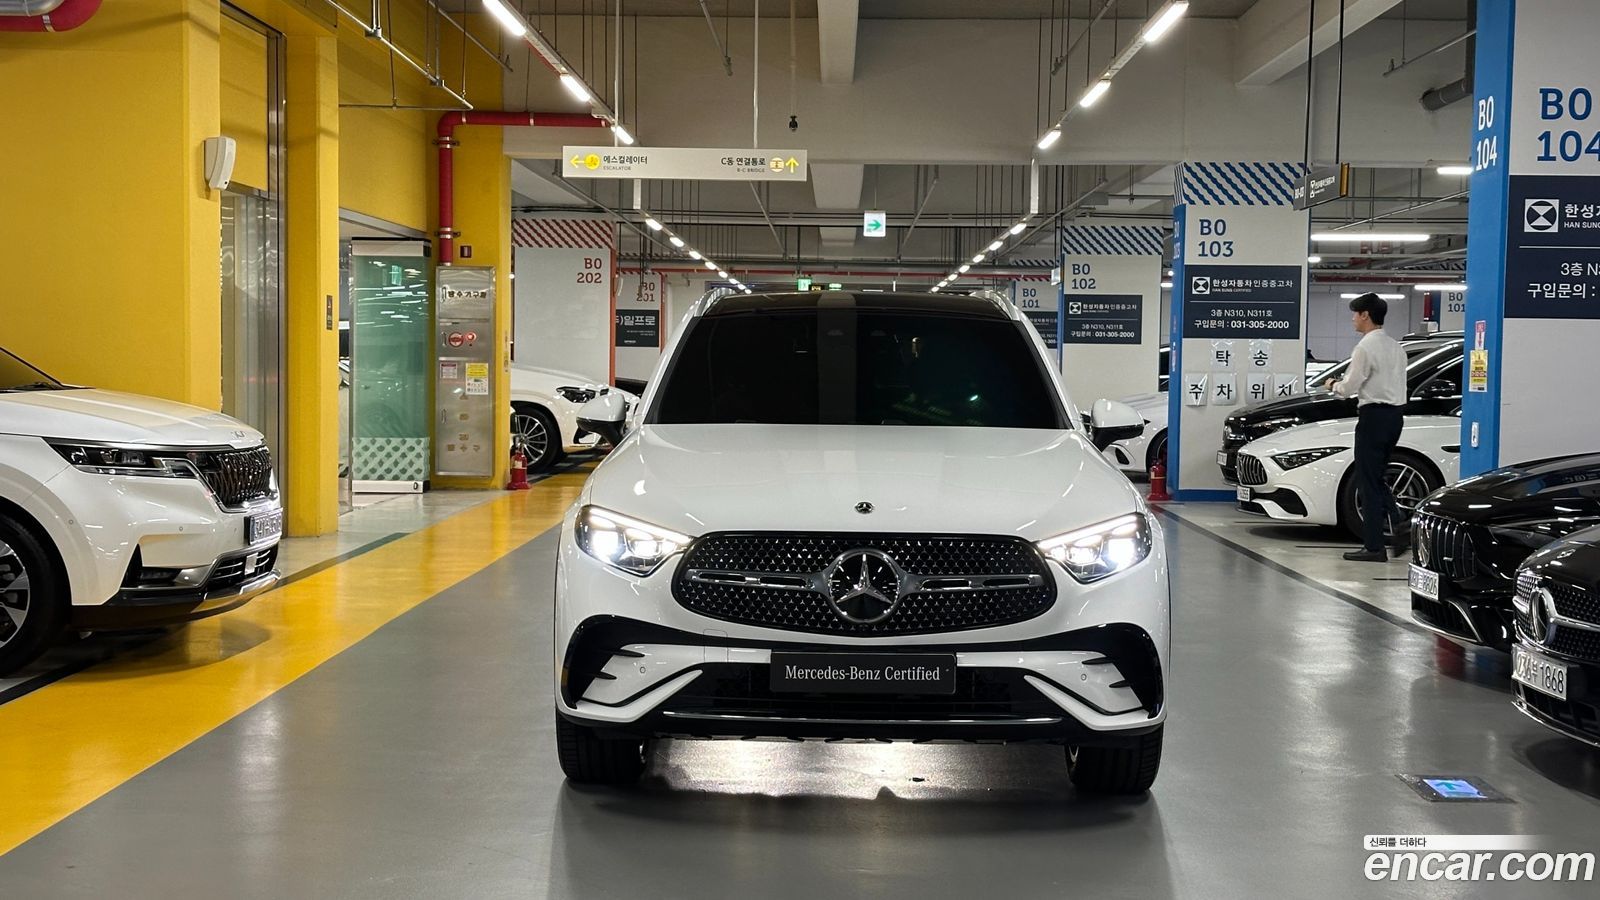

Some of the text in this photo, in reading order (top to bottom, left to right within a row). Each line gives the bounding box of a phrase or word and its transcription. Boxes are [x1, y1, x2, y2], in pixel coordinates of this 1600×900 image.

[1539, 87, 1593, 121] B0
[1478, 95, 1495, 131] B0
[1537, 130, 1600, 162] 104
[1475, 135, 1498, 171] 104
[603, 155, 648, 165] 에스컬레이터
[720, 157, 766, 166] C동 연결통로
[1199, 218, 1227, 237] B0
[1563, 221, 1580, 229] HAN
[1198, 240, 1234, 258] 103
[584, 257, 602, 270] B0
[1072, 263, 1091, 276] B0
[1560, 262, 1584, 277] 3층
[576, 272, 602, 284] 202
[1071, 278, 1097, 290] 102
[1212, 279, 1252, 288] 한성자동차
[1527, 282, 1587, 299] 구입문의
[1022, 299, 1040, 308] 101
[1448, 303, 1466, 313] 101
[1194, 319, 1225, 329] 구입문의
[1230, 320, 1290, 329] 031-305-2000
[785, 665, 940, 681] Mercedes-Benz Certified
